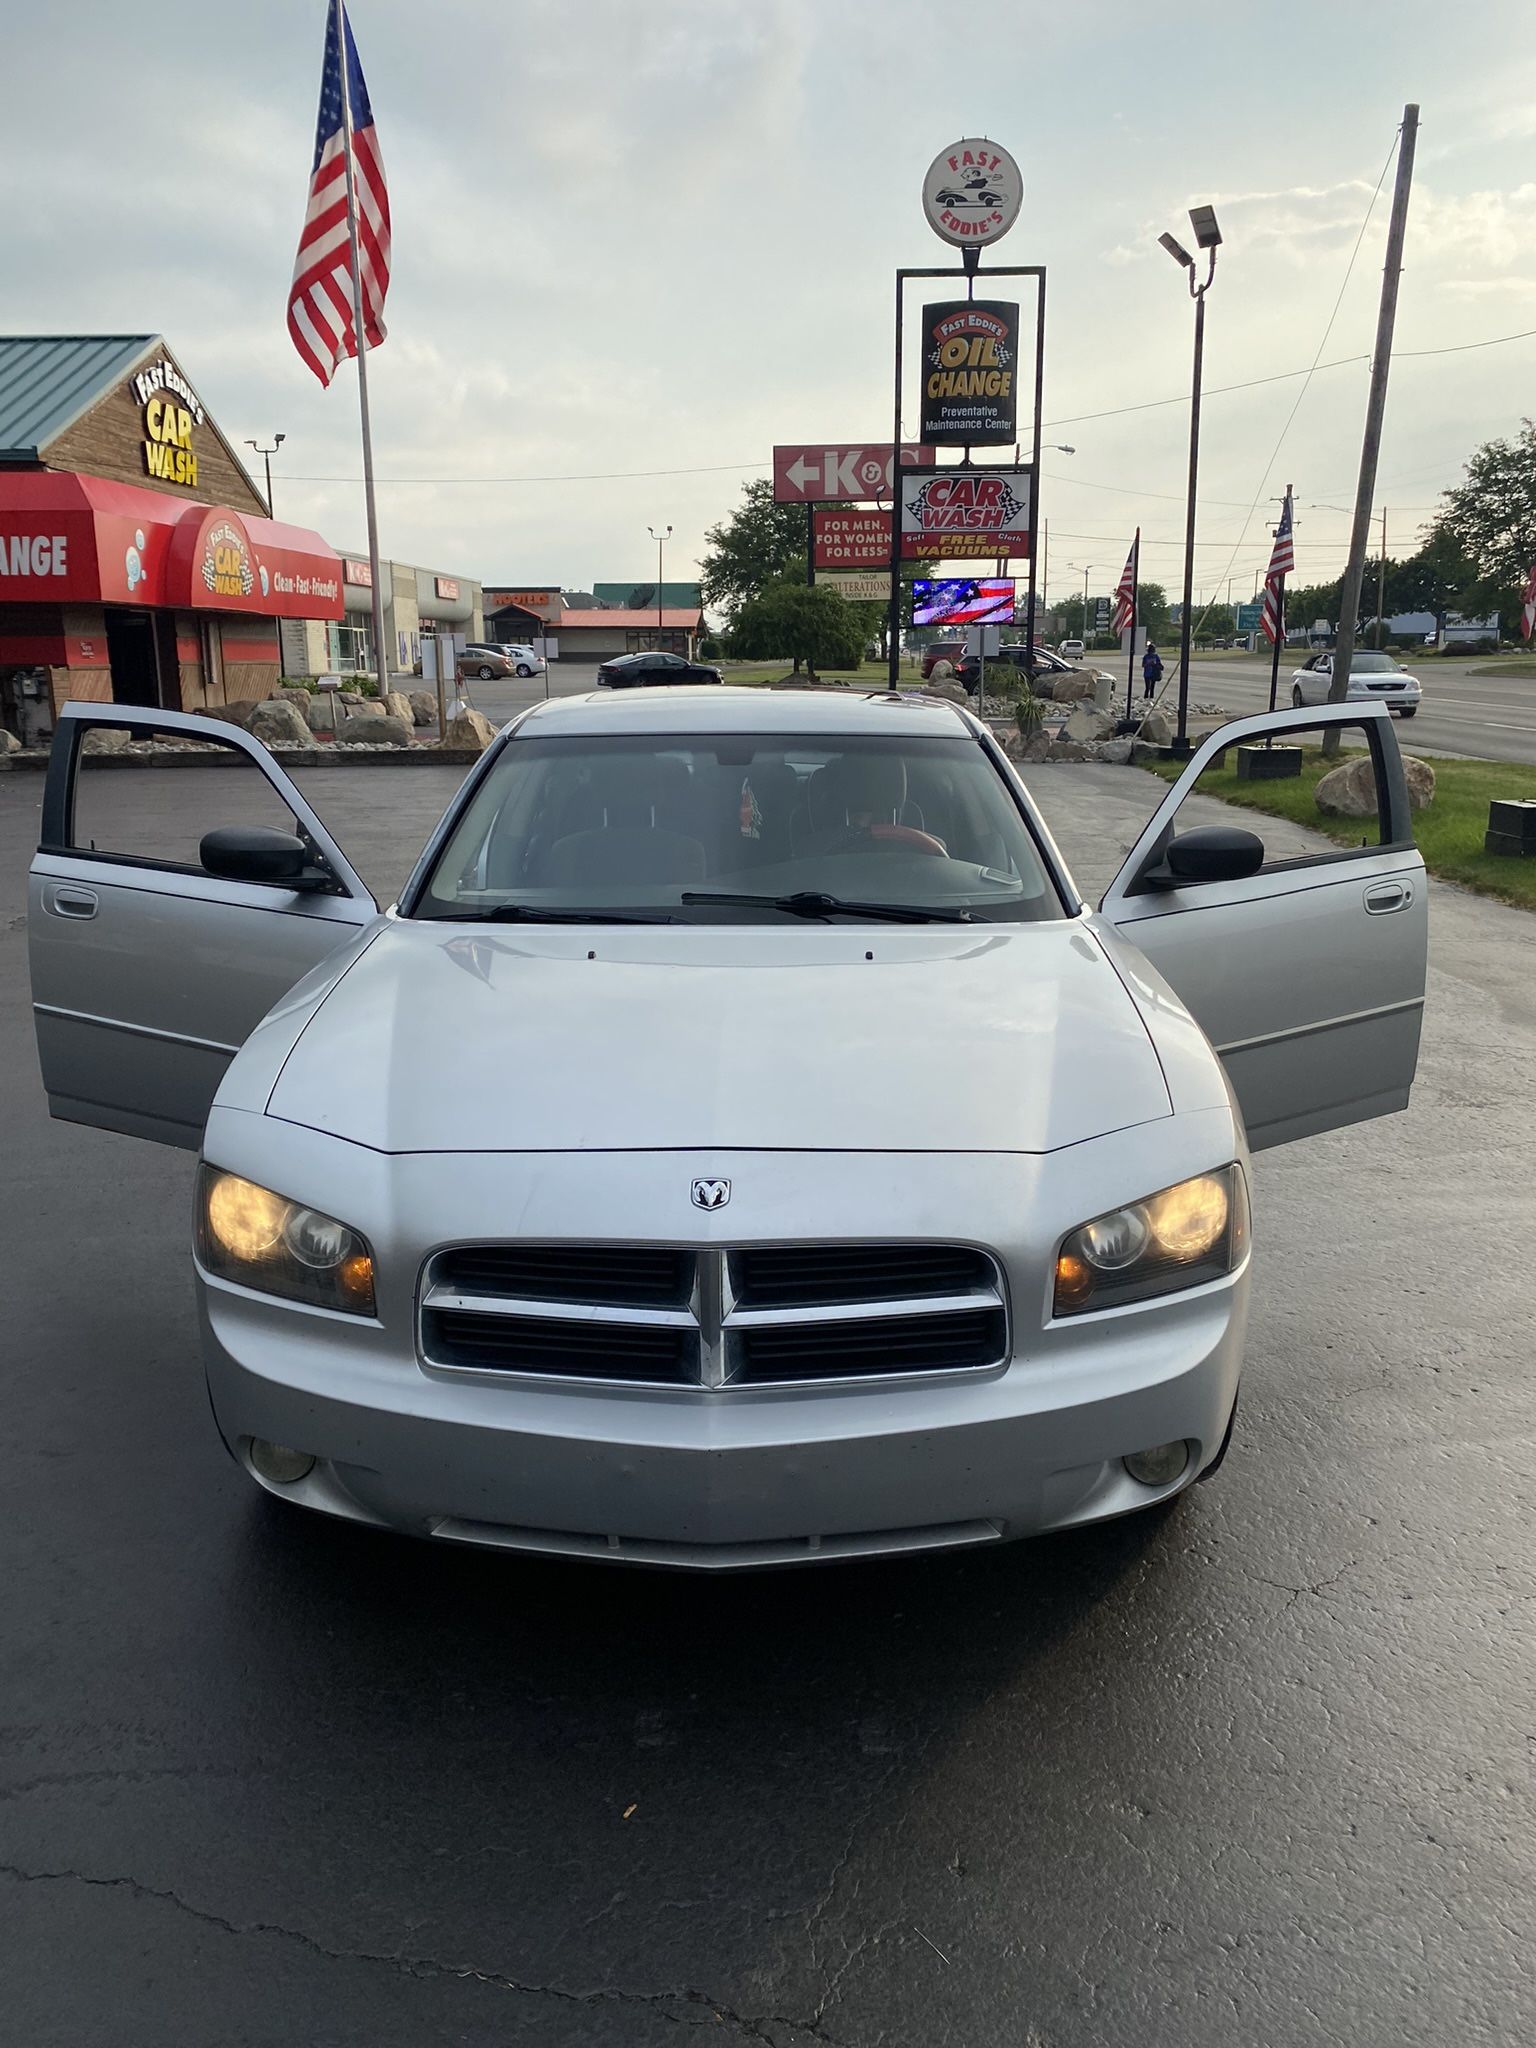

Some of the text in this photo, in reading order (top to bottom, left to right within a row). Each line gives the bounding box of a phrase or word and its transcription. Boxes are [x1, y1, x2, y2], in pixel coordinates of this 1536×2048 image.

[947, 150, 1002, 172] FAST
[939, 209, 1004, 235] EDDIE'S
[940, 314, 1003, 337] FAST EDDIE'S
[940, 336, 1000, 368] OIL
[135, 368, 165, 405] FAST
[927, 370, 1012, 399] CHANGE
[941, 405, 998, 417] Preventative
[146, 398, 192, 450] CAR
[925, 418, 1012, 431] Maintenance Center
[145, 441, 198, 487] WASH
[926, 478, 1005, 508] CAR
[824, 520, 885, 531] FOR MEN.
[921, 507, 1006, 529] WASH
[816, 533, 893, 545] FOR WOMEN
[906, 532, 1022, 545] Soft FREE Cloth
[215, 546, 240, 576] CAR
[826, 547, 851, 558] FOR
[916, 545, 1011, 556] VACUUMS
[215, 574, 243, 596] WASH
[273, 571, 293, 592] Clean
[296, 574, 310, 594] Fast
